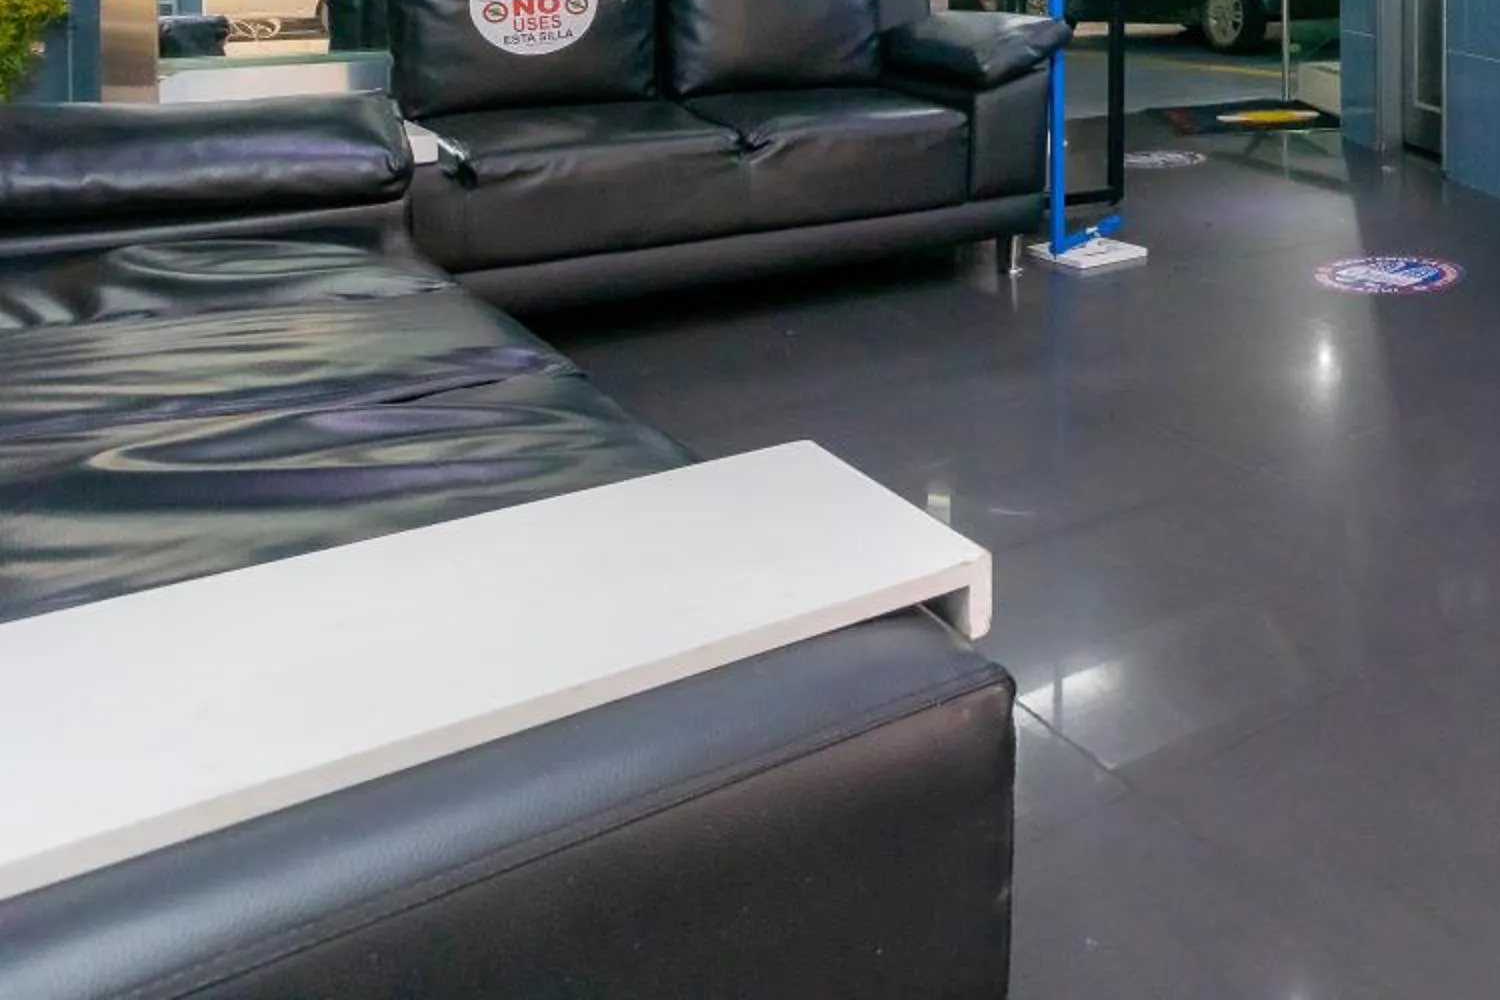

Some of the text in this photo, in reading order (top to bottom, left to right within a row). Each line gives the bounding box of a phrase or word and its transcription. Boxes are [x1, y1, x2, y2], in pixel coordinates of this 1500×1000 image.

[513, 15, 562, 33] USES
[503, 29, 574, 46] ESTA SILLA
